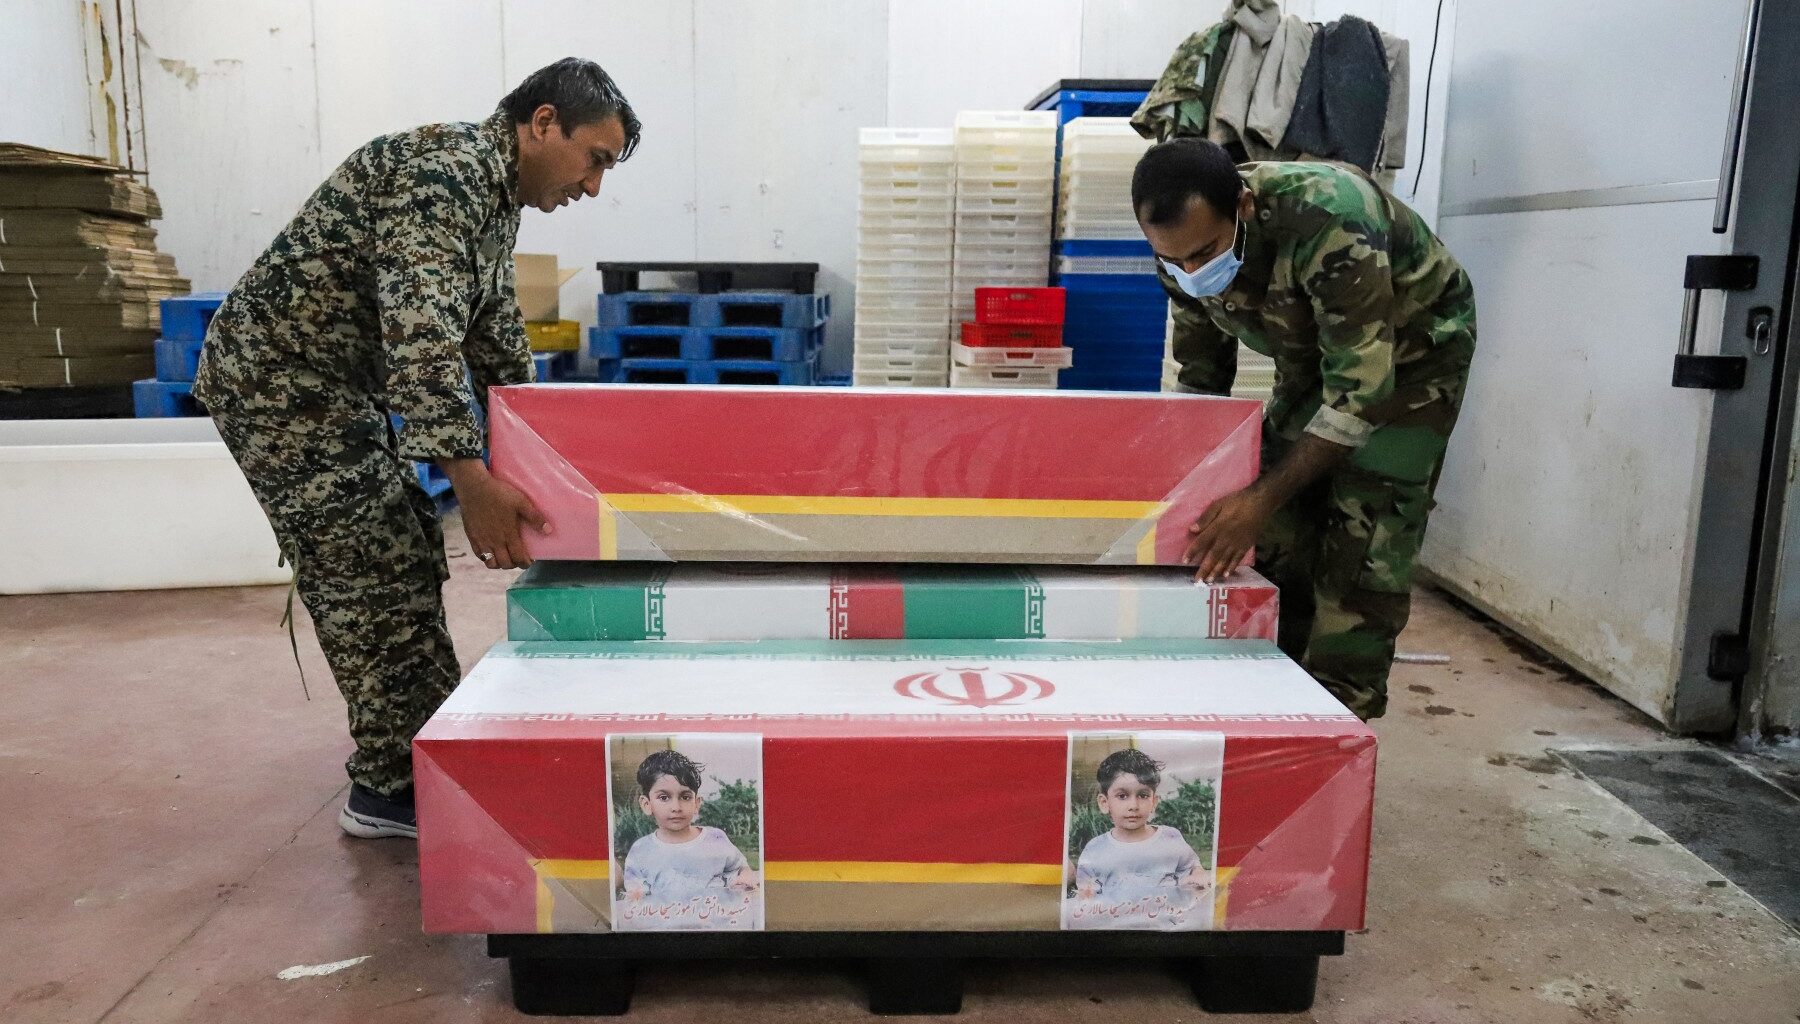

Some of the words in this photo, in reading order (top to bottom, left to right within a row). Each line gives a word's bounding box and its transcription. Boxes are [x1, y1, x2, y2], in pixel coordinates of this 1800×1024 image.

[623, 904, 658, 920] سالاری
[675, 897, 700, 916] آموز
[699, 895, 725, 920] دانش
[727, 897, 750, 924] شهید
